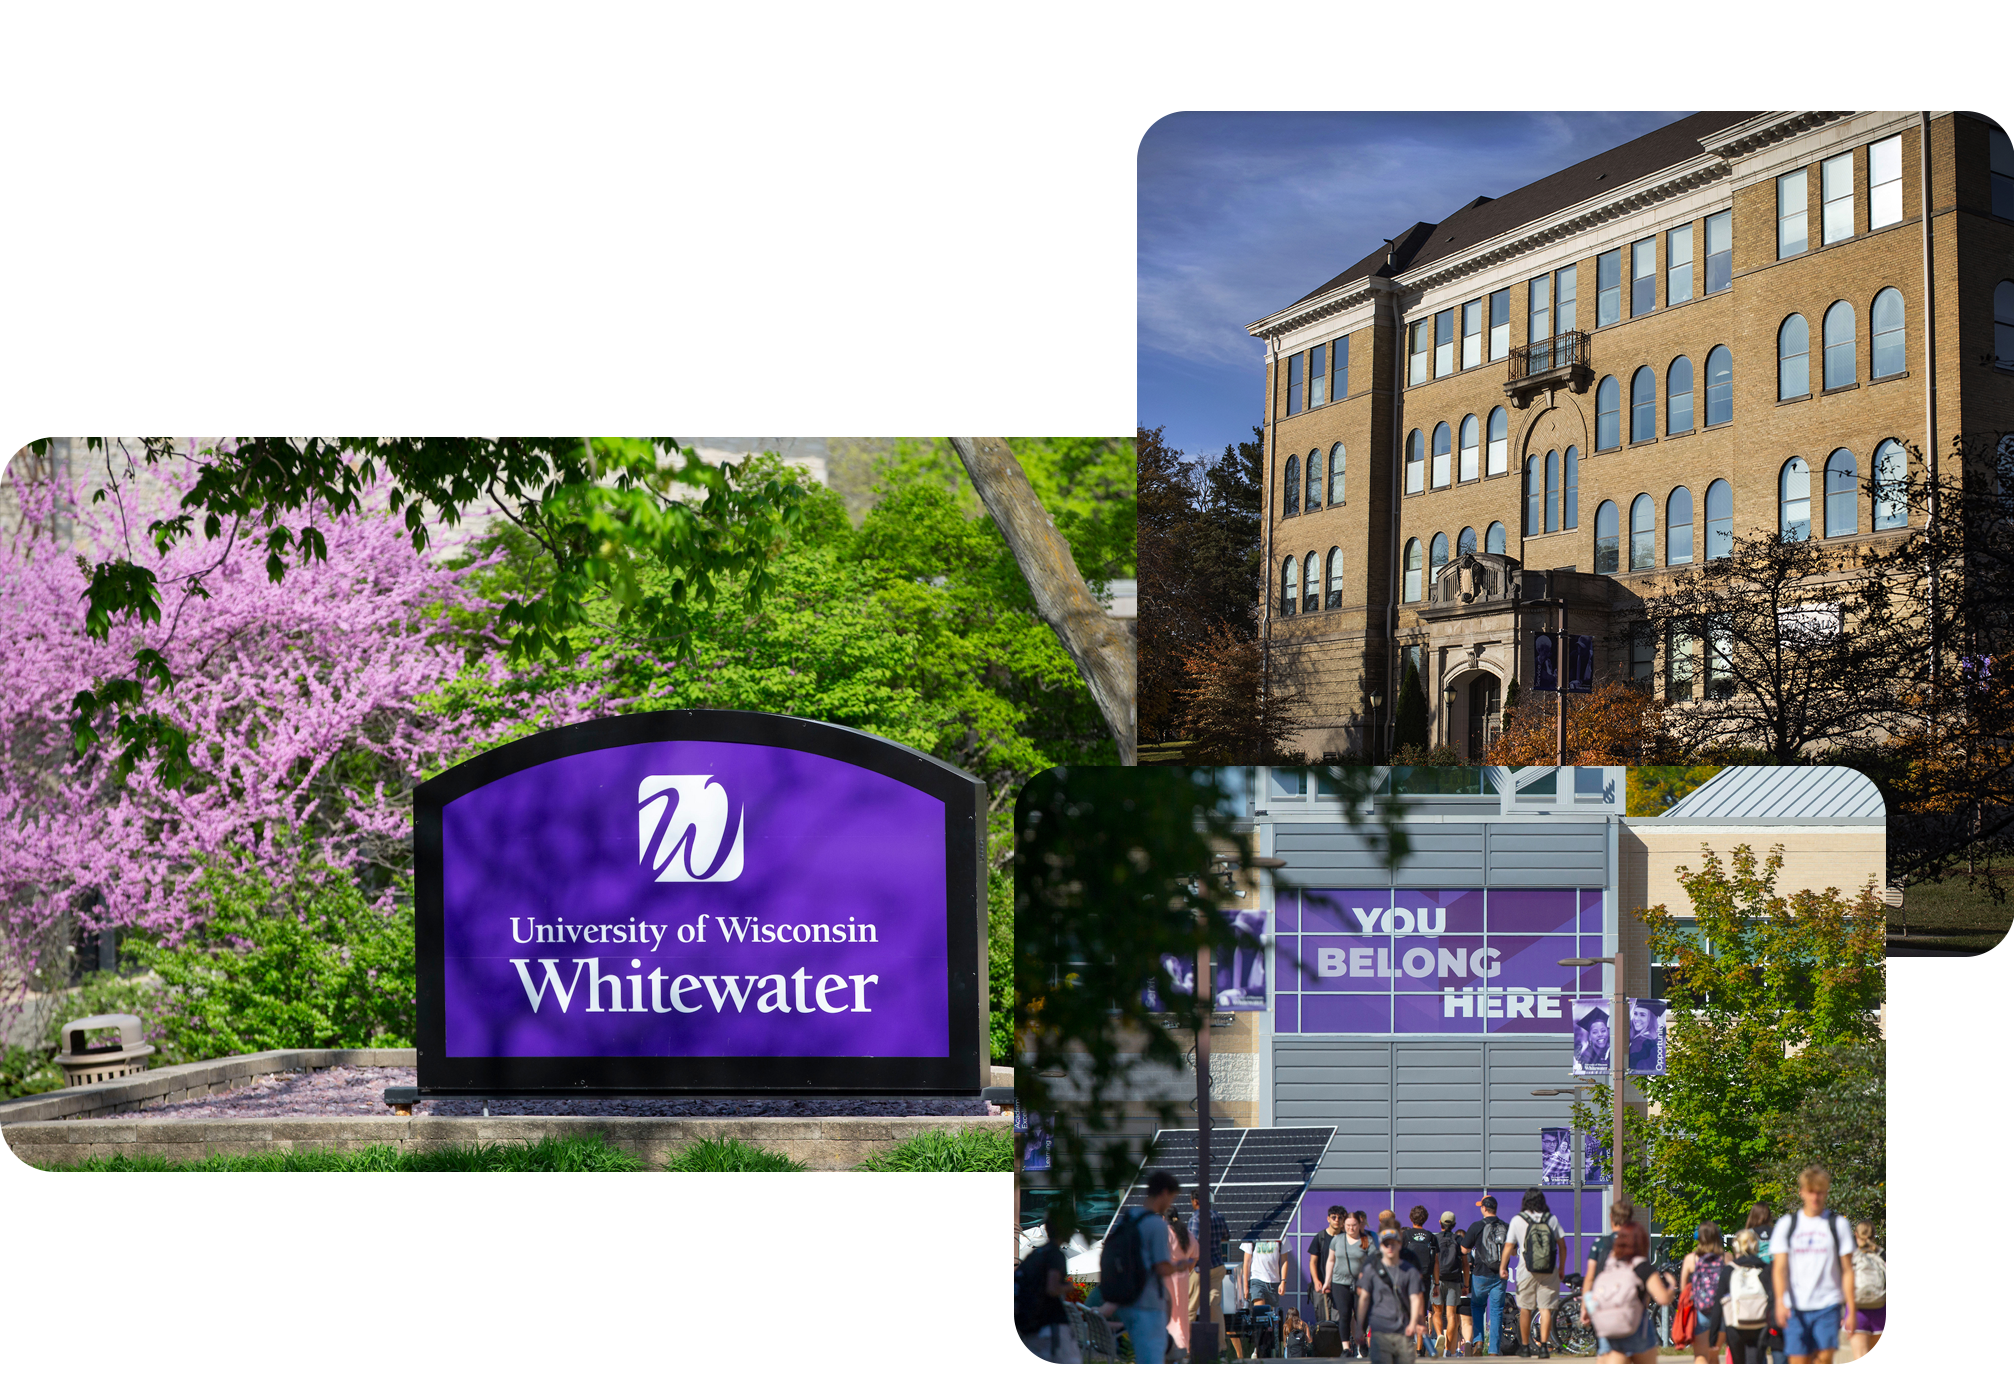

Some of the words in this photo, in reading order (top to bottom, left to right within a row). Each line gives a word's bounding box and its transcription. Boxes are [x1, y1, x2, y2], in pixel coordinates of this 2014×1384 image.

[510, 917, 667, 952] University
[678, 914, 709, 943] of
[715, 917, 878, 943] Wisconsin
[1352, 907, 1446, 938] YOU
[1318, 947, 1501, 978] BELONG
[510, 957, 878, 1014] Whitewater
[1444, 987, 1562, 1018] HERE
[1655, 1023, 1665, 1071] Opportunity
